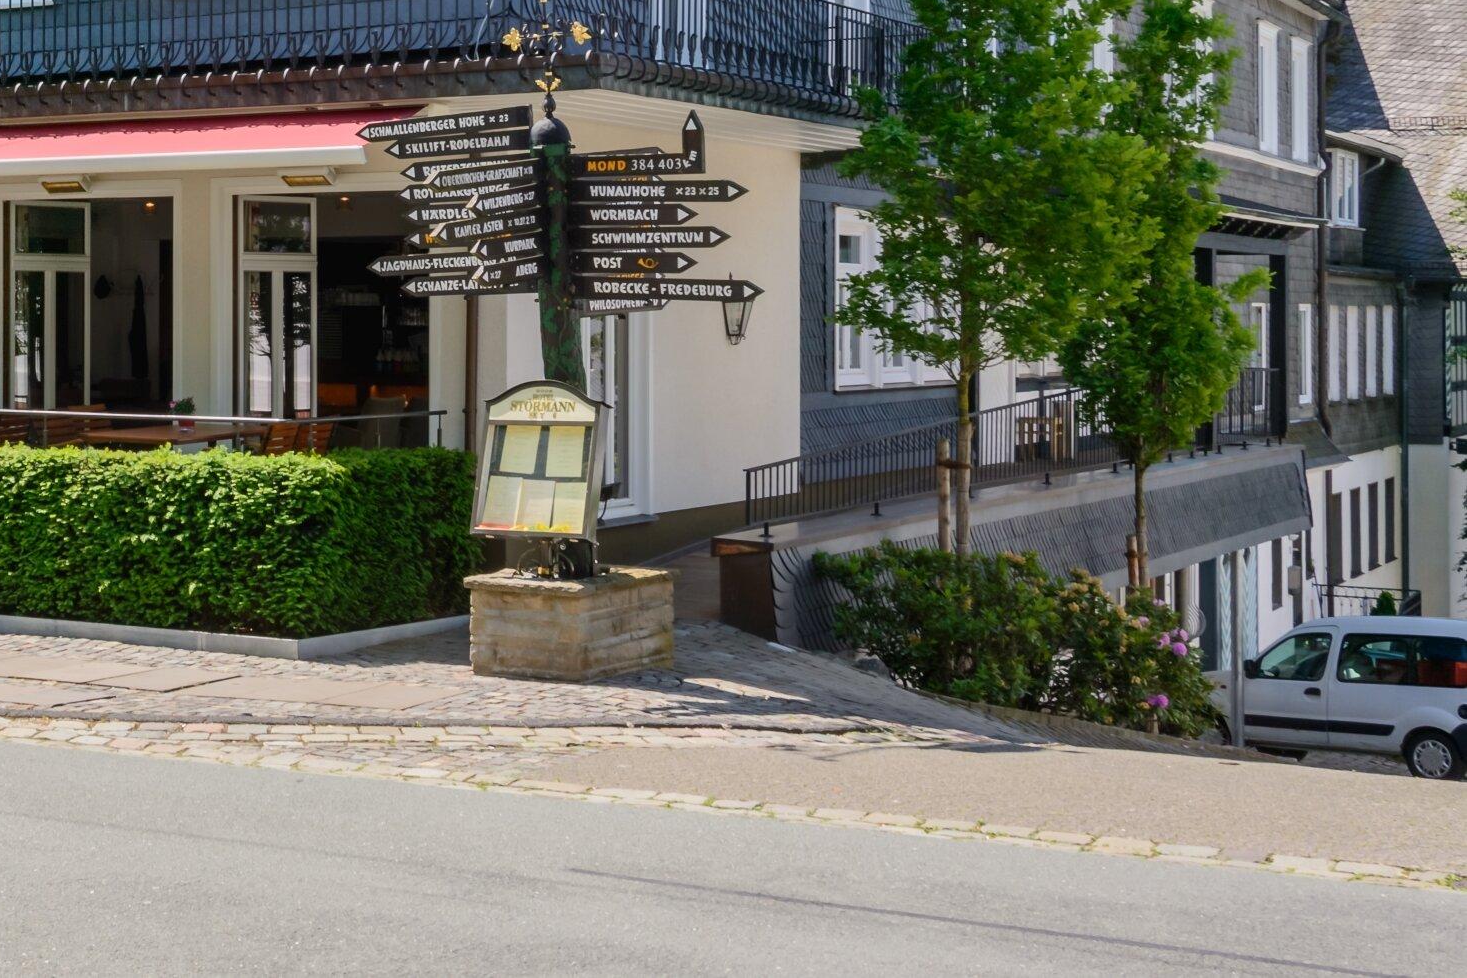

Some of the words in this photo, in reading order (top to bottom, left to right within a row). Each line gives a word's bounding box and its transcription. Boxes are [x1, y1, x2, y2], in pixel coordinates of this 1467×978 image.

[370, 119, 457, 138] SCHMALLENBERGER
[499, 114, 509, 123] 23
[405, 135, 510, 155] SKILIFT-RODELBAHN
[587, 160, 626, 172] MOND
[631, 159, 654, 171] 384
[658, 158, 682, 170] 403
[441, 166, 523, 187] OBERKIRCHEN-GRAFSCHAFT
[685, 186, 696, 196] 23
[708, 186, 719, 196] 25
[590, 209, 659, 221] WORMBACH
[482, 220, 504, 235] ASTEN
[504, 238, 537, 253] KURPARK
[591, 232, 704, 244] SCHWIMMZENTRUM
[516, 262, 538, 278] ABERG
[593, 257, 622, 269] POST
[660, 283, 733, 298] FREDEBURG
